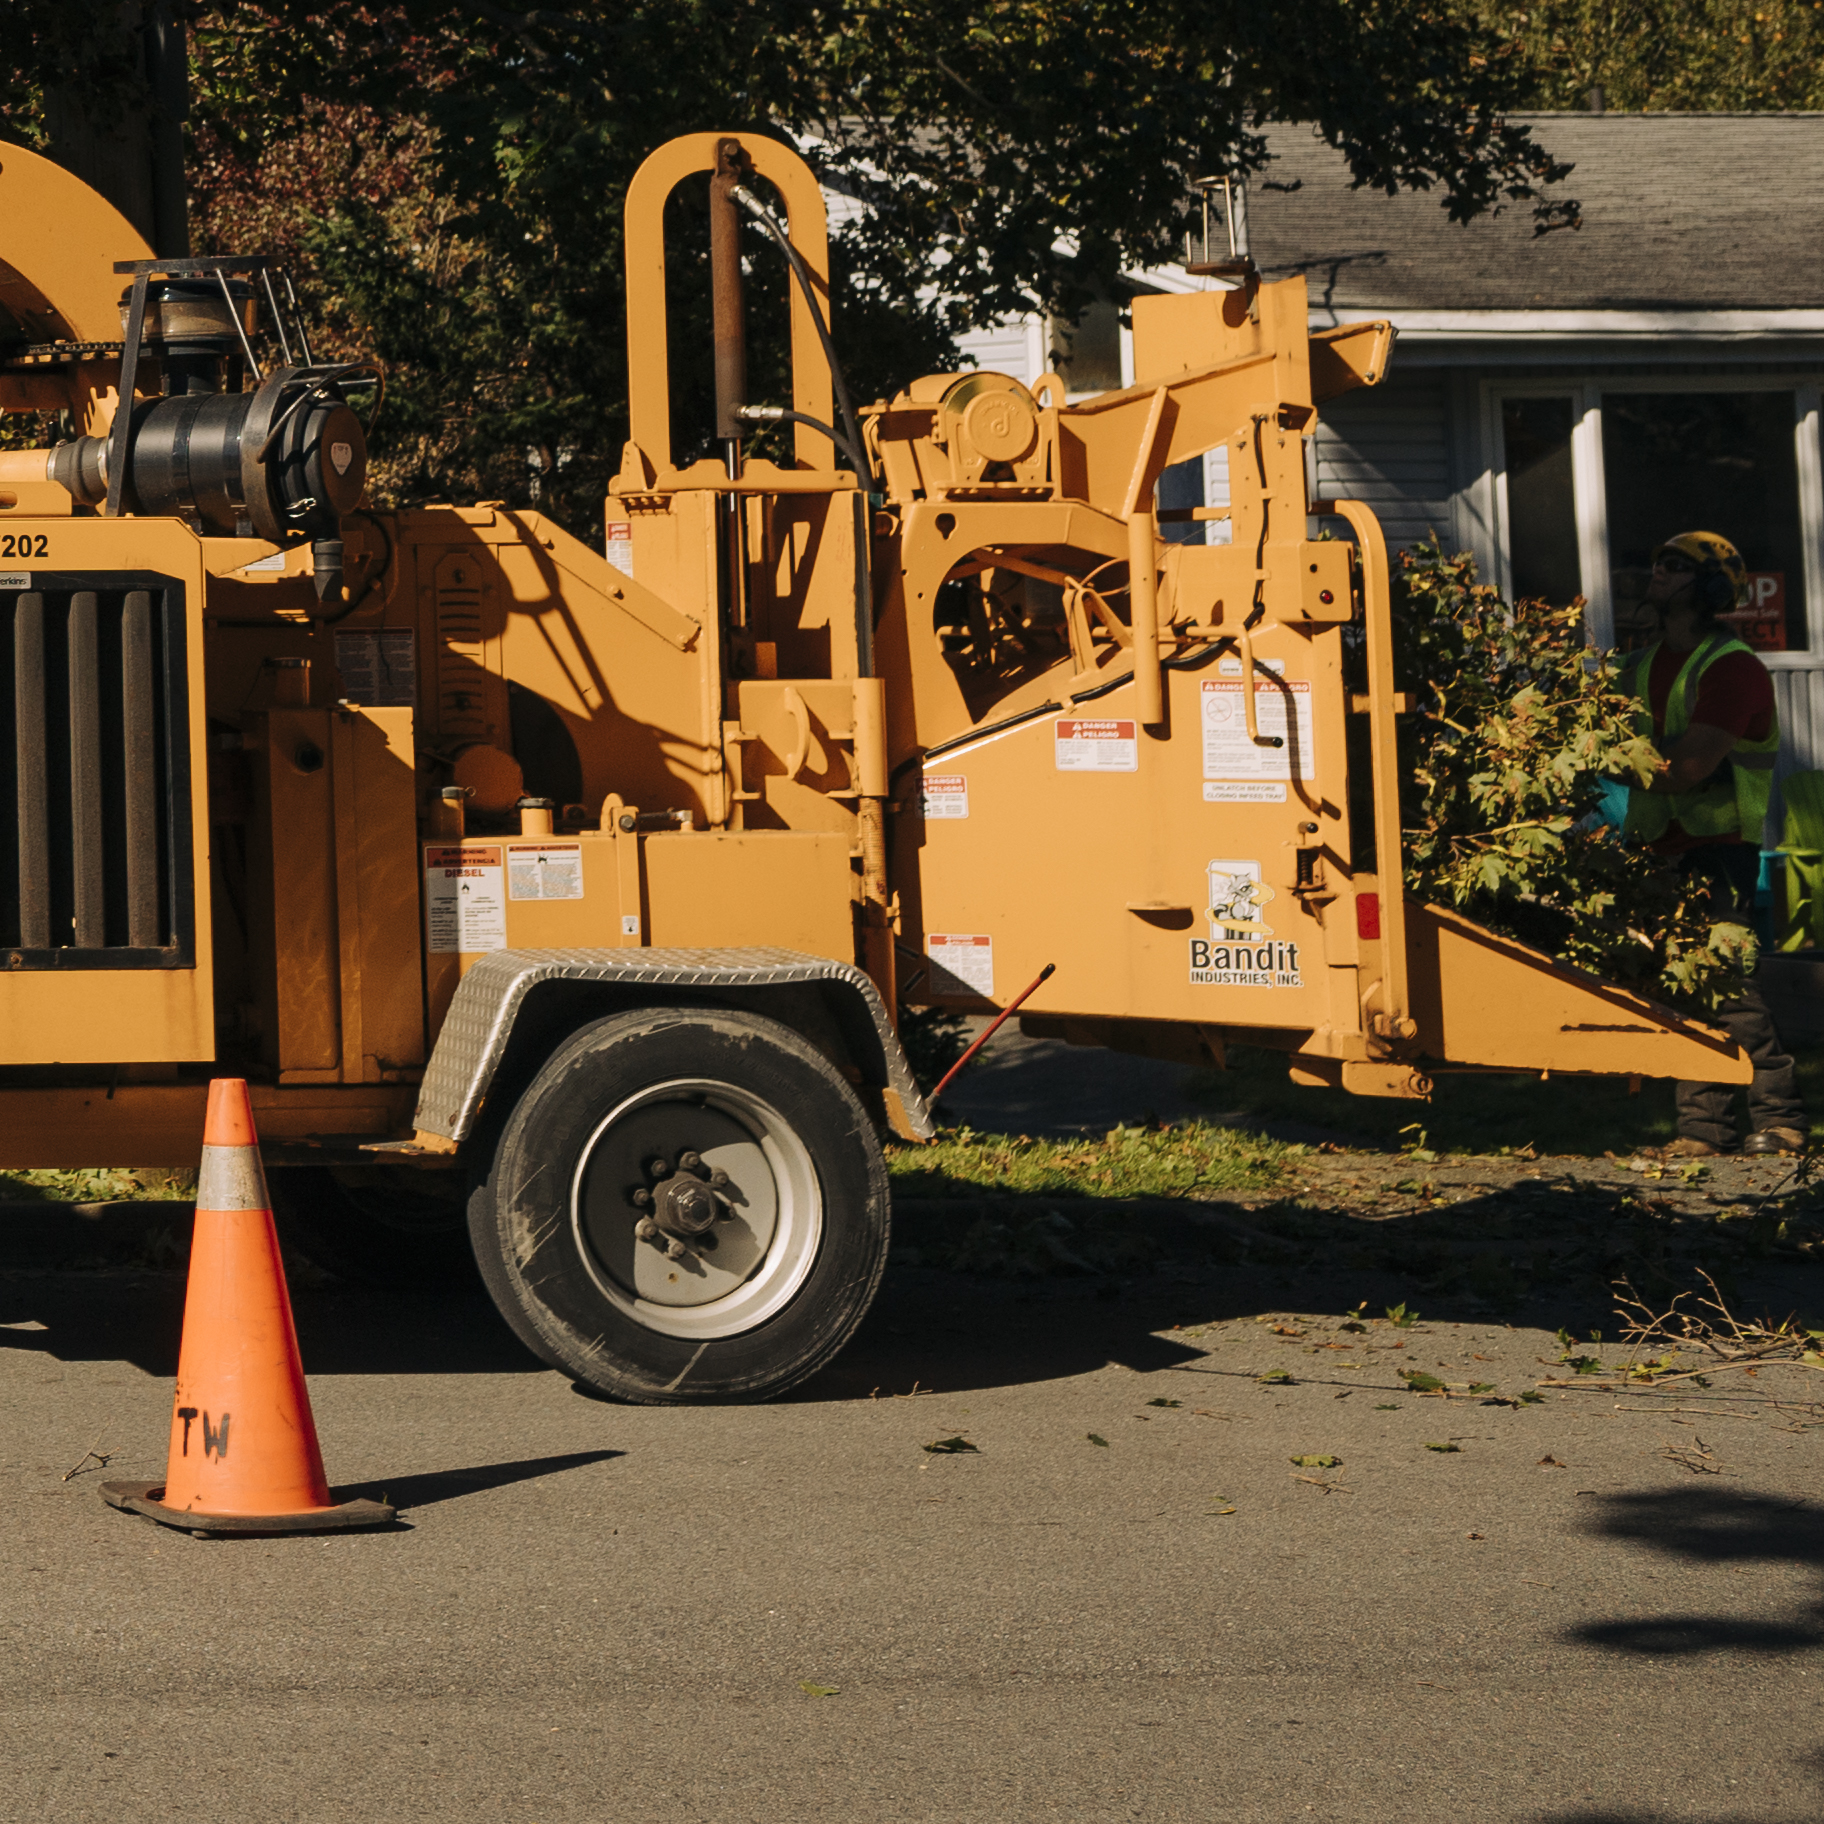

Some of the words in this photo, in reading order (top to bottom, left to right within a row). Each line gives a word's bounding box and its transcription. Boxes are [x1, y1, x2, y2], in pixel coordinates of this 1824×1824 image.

[1082, 722, 1118, 730] DANGER
[444, 869, 485, 877] DIESEL
[1190, 939, 1299, 972] Bandit
[1190, 971, 1273, 987] INDUSTRIES,
[1277, 973, 1304, 986] INC.
[177, 1407, 231, 1460] TW
